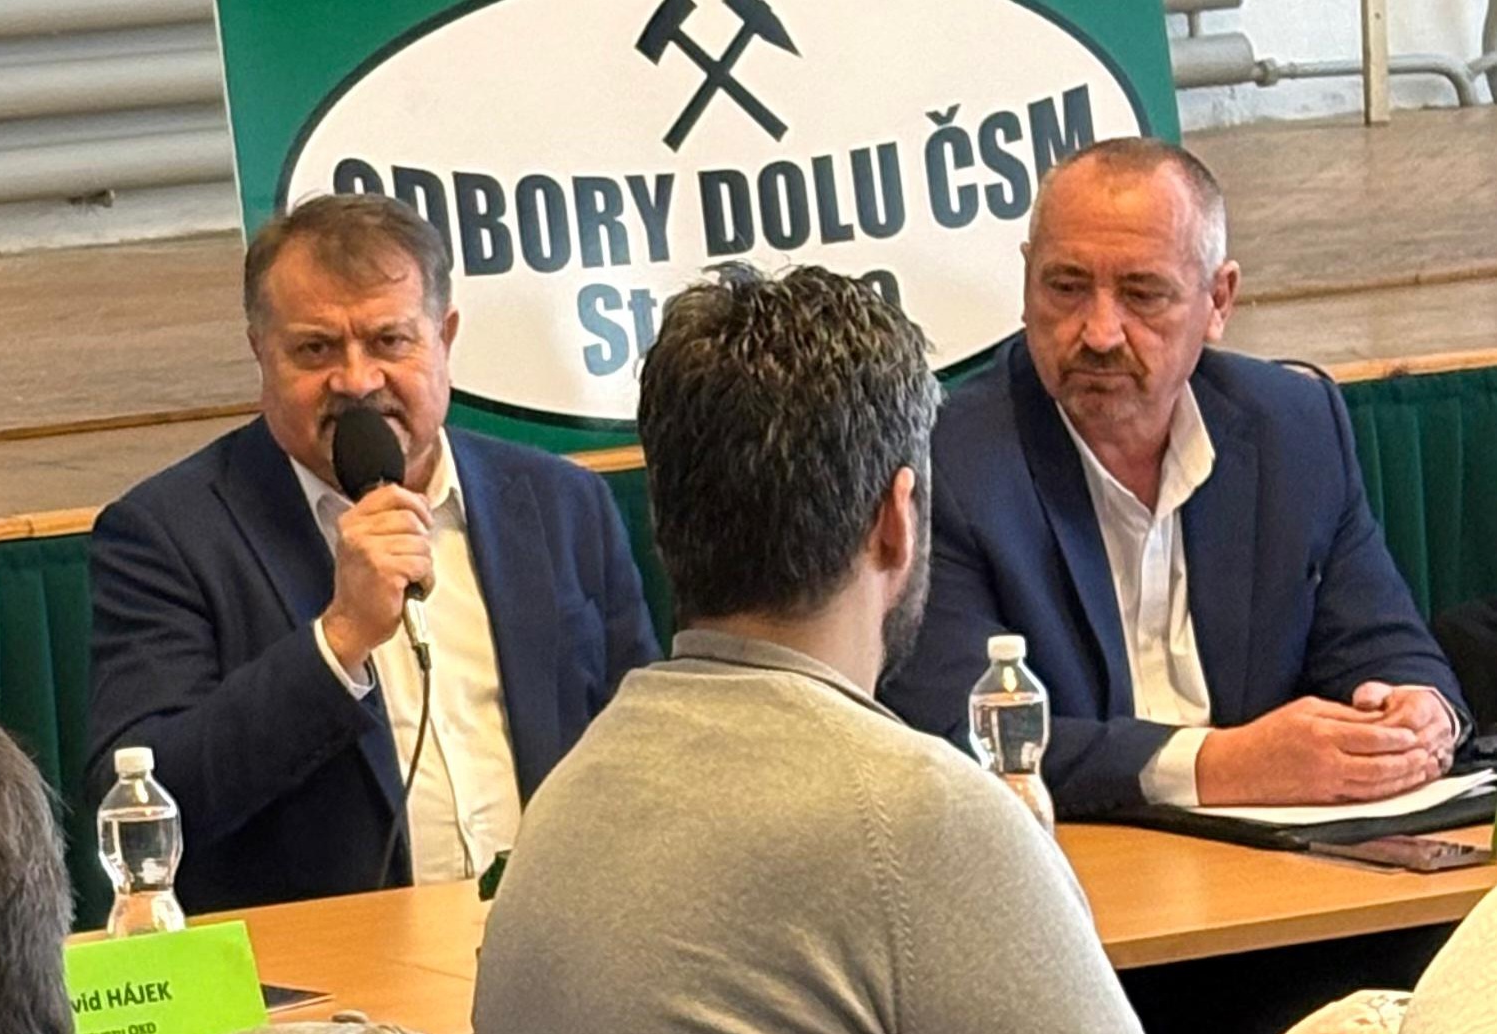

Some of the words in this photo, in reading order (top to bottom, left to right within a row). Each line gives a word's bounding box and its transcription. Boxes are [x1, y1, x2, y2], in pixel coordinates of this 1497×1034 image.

[697, 141, 906, 258] DOLU
[924, 83, 1095, 230] ČSM
[70, 989, 102, 1013] vid
[106, 981, 173, 1009] HÁJEK
